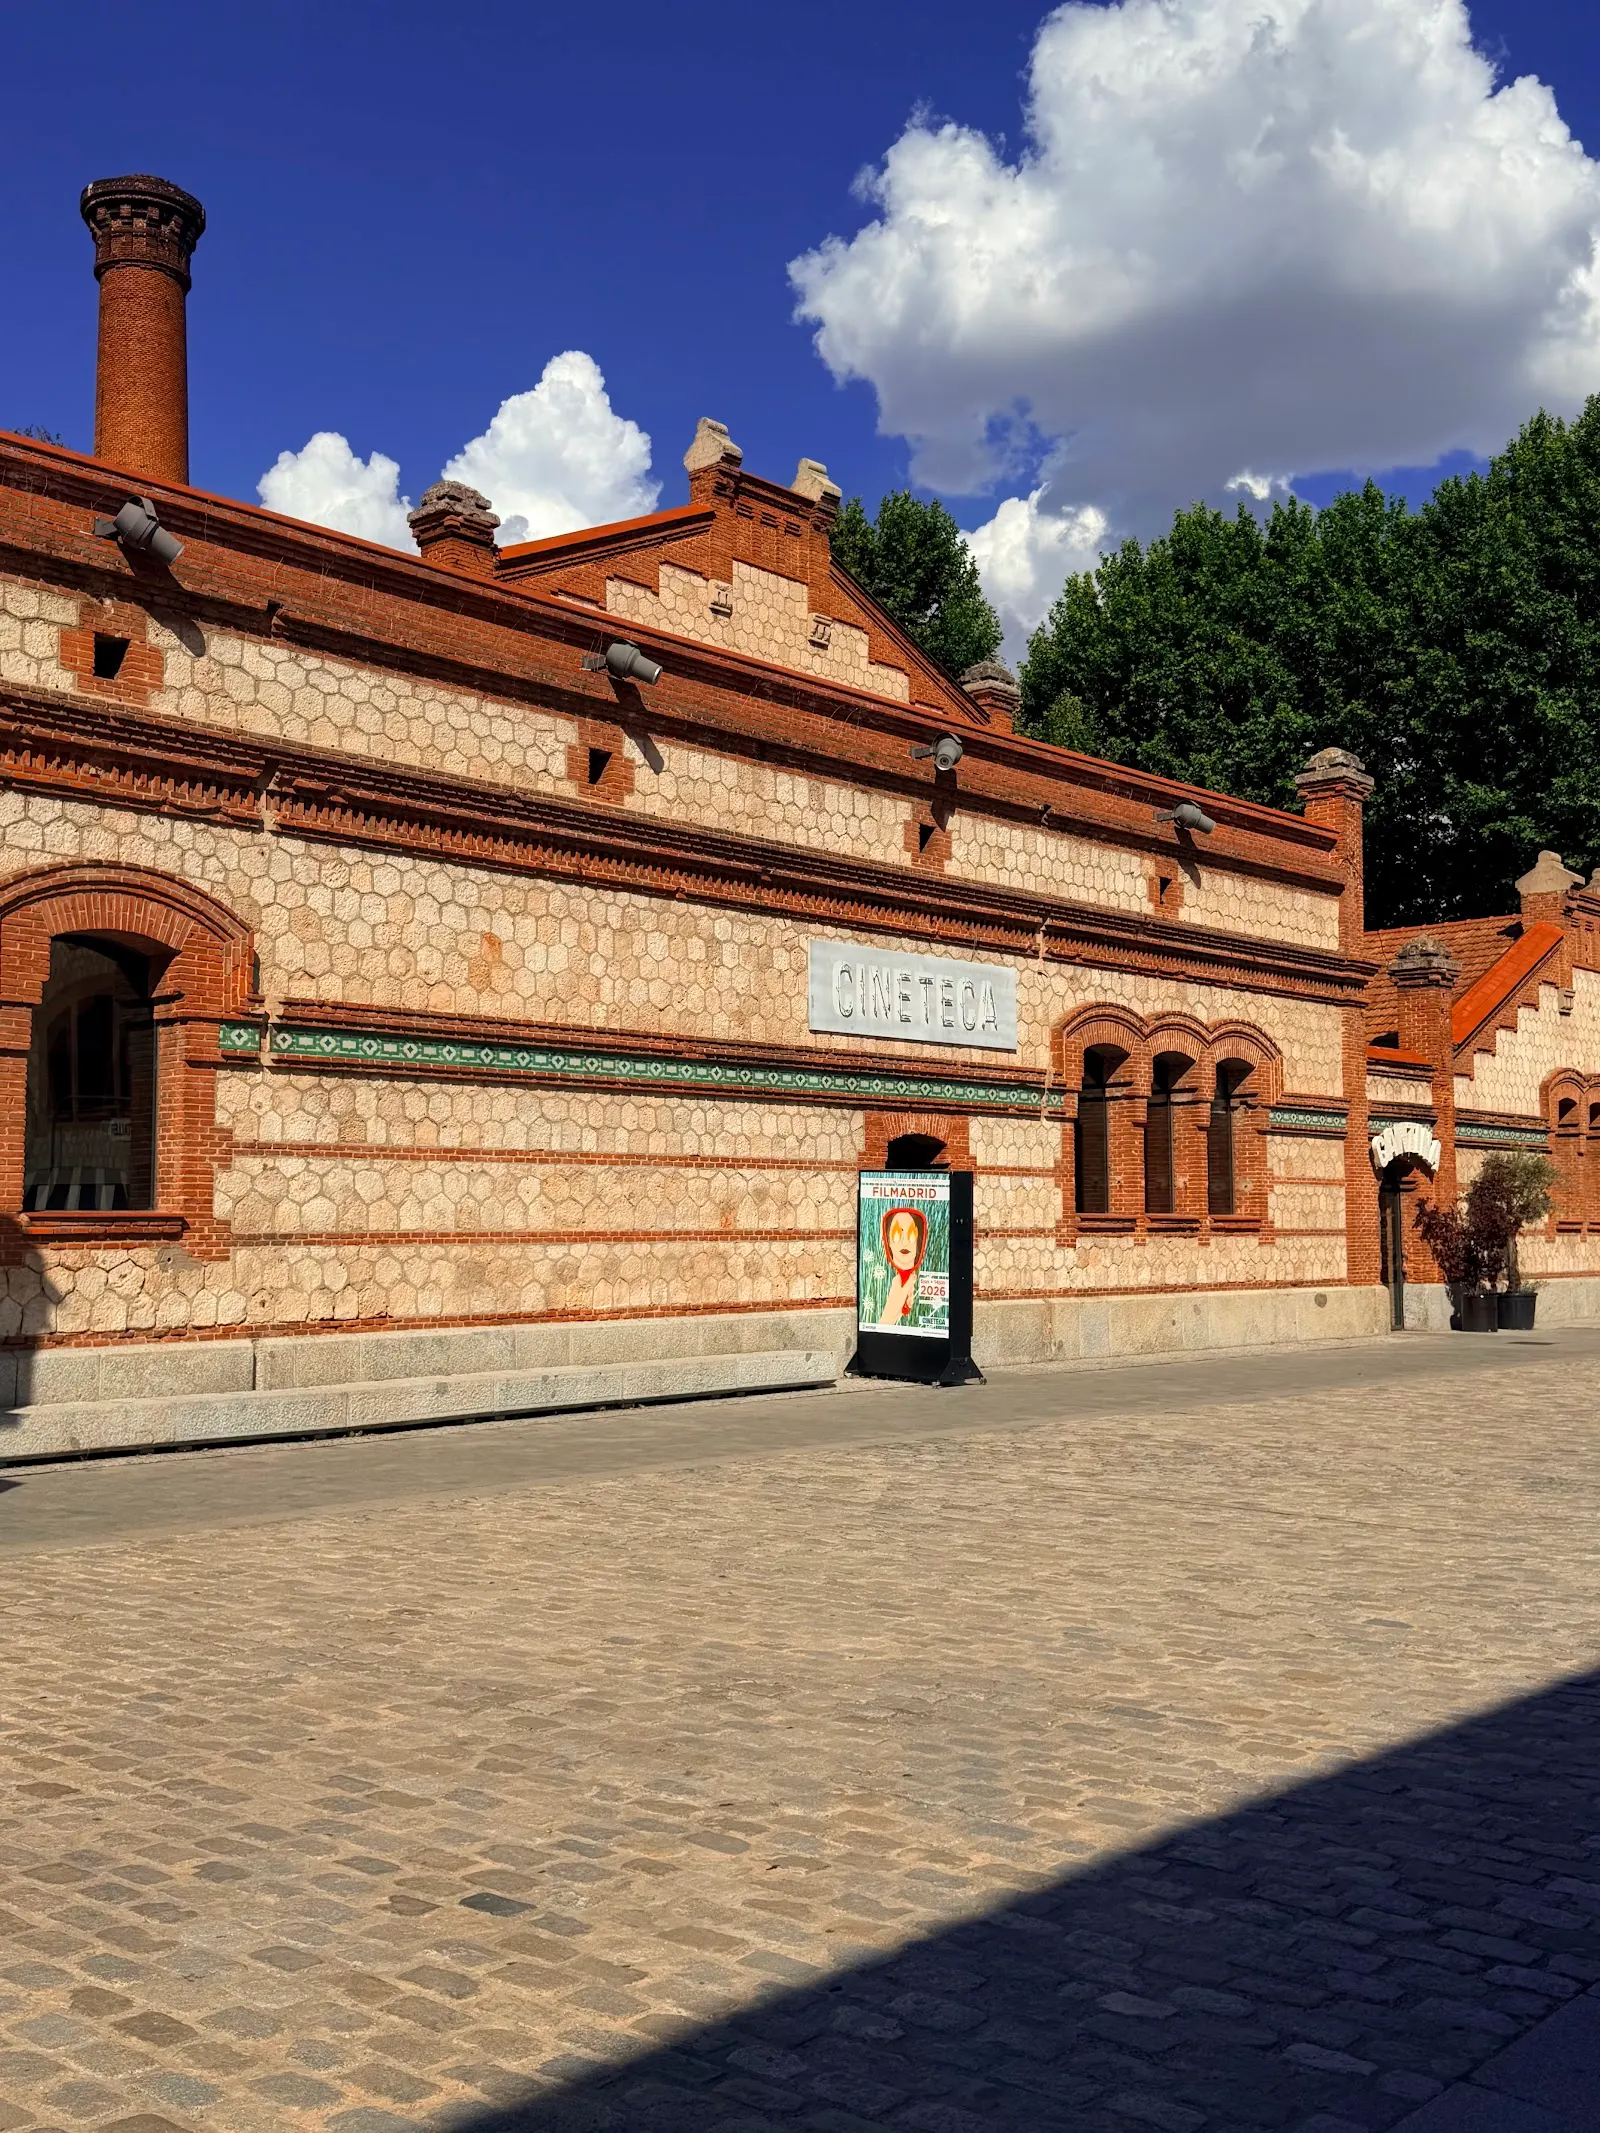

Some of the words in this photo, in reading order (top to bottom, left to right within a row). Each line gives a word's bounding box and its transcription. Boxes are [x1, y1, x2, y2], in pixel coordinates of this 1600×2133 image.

[832, 959, 999, 1031] CINETECA
[872, 1187, 937, 1199] FILMADRID
[920, 1285, 946, 1297] 2026
[922, 1317, 946, 1325] CINETECA
